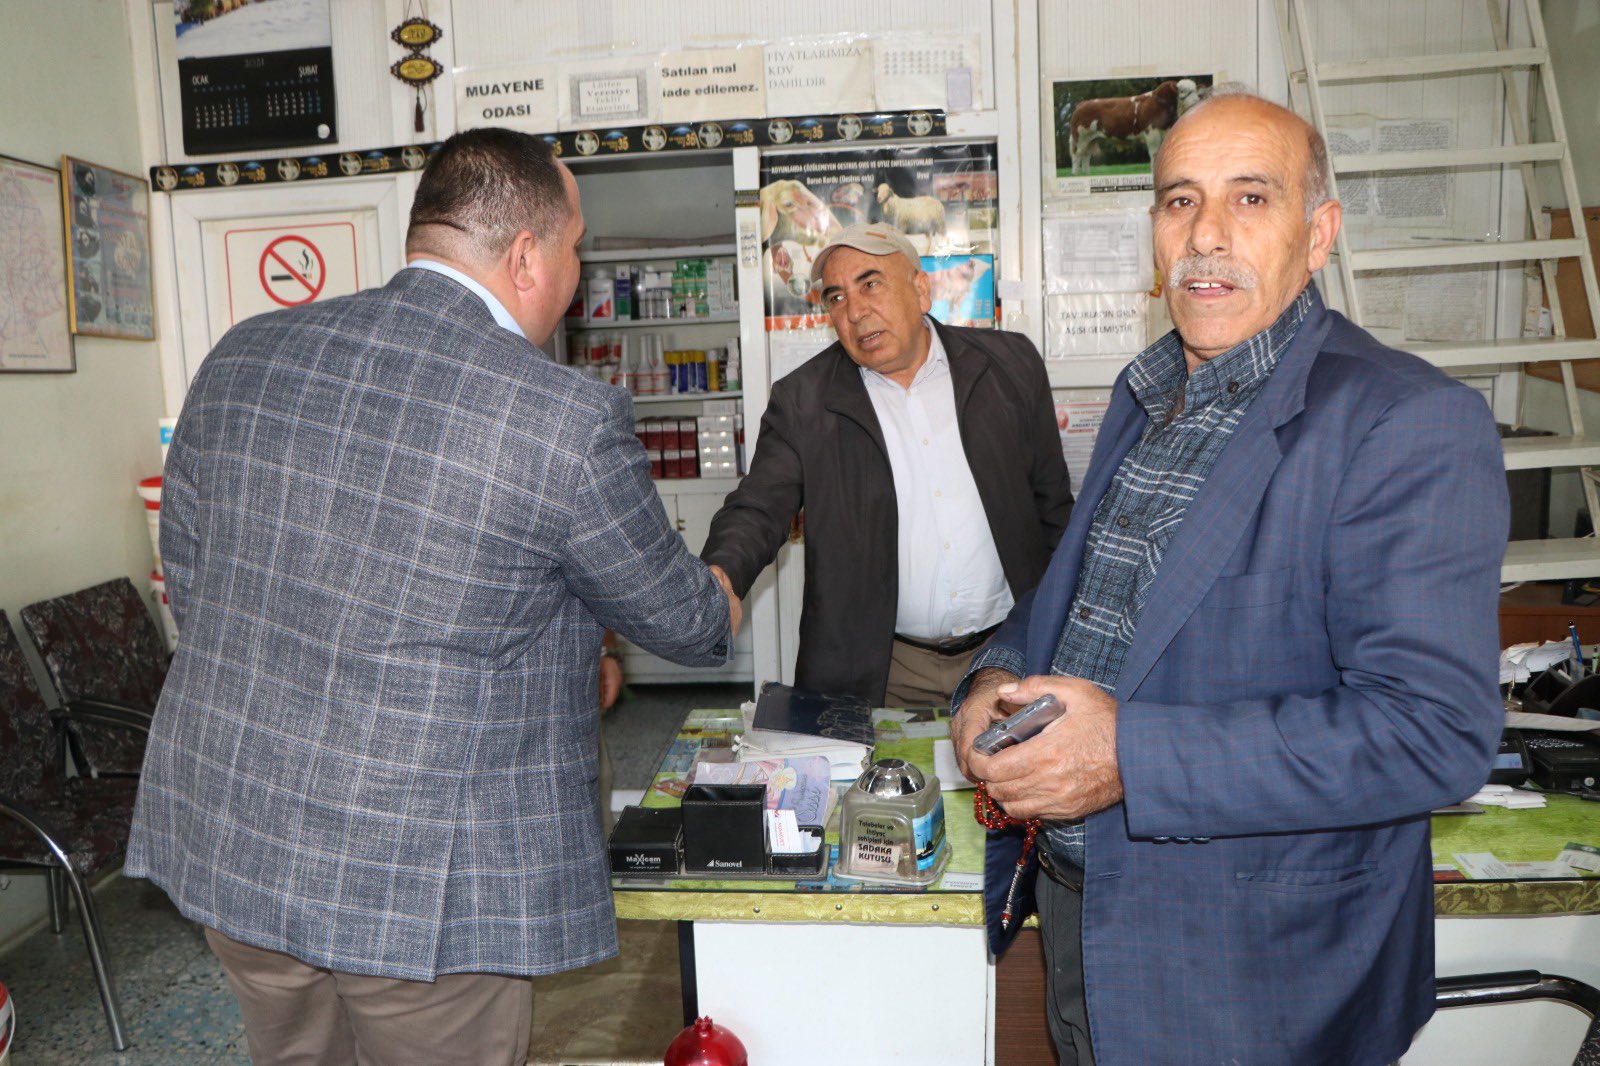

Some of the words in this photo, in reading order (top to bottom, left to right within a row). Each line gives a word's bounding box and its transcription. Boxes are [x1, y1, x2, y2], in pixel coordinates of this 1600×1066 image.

[661, 65, 708, 78] Satılan
[712, 62, 737, 74] mal
[768, 65, 793, 76] KDV
[192, 74, 209, 85] OCAK
[465, 78, 545, 98] MUAYENE
[661, 86, 691, 98] iade
[694, 83, 759, 96] edilemez.
[482, 104, 531, 120] ODASI
[858, 819, 886, 830] Talebeler
[858, 843, 892, 855] SADAKA
[714, 859, 743, 868] Sanovel
[858, 852, 892, 864] KUTUSU
